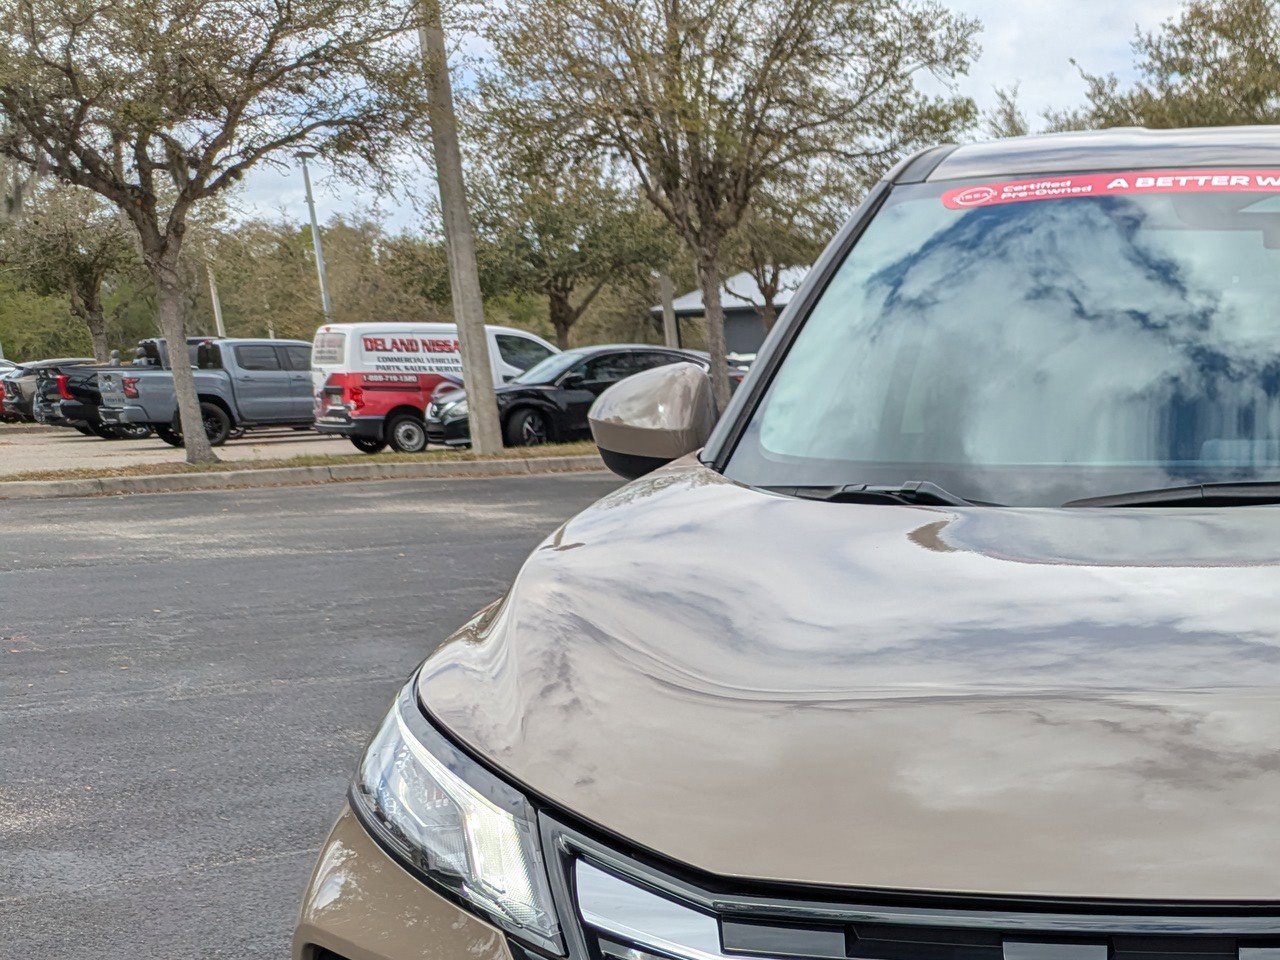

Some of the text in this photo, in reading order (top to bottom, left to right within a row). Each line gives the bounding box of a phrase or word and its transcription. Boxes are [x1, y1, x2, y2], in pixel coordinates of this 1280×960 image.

[1003, 180, 1072, 193] Certified
[1107, 177, 1130, 188] A
[1135, 175, 1250, 188] BETTER
[1001, 185, 1093, 200] Pre-Owned
[363, 337, 460, 353] DELAND NISSA
[377, 356, 425, 364] COMMERCIAL
